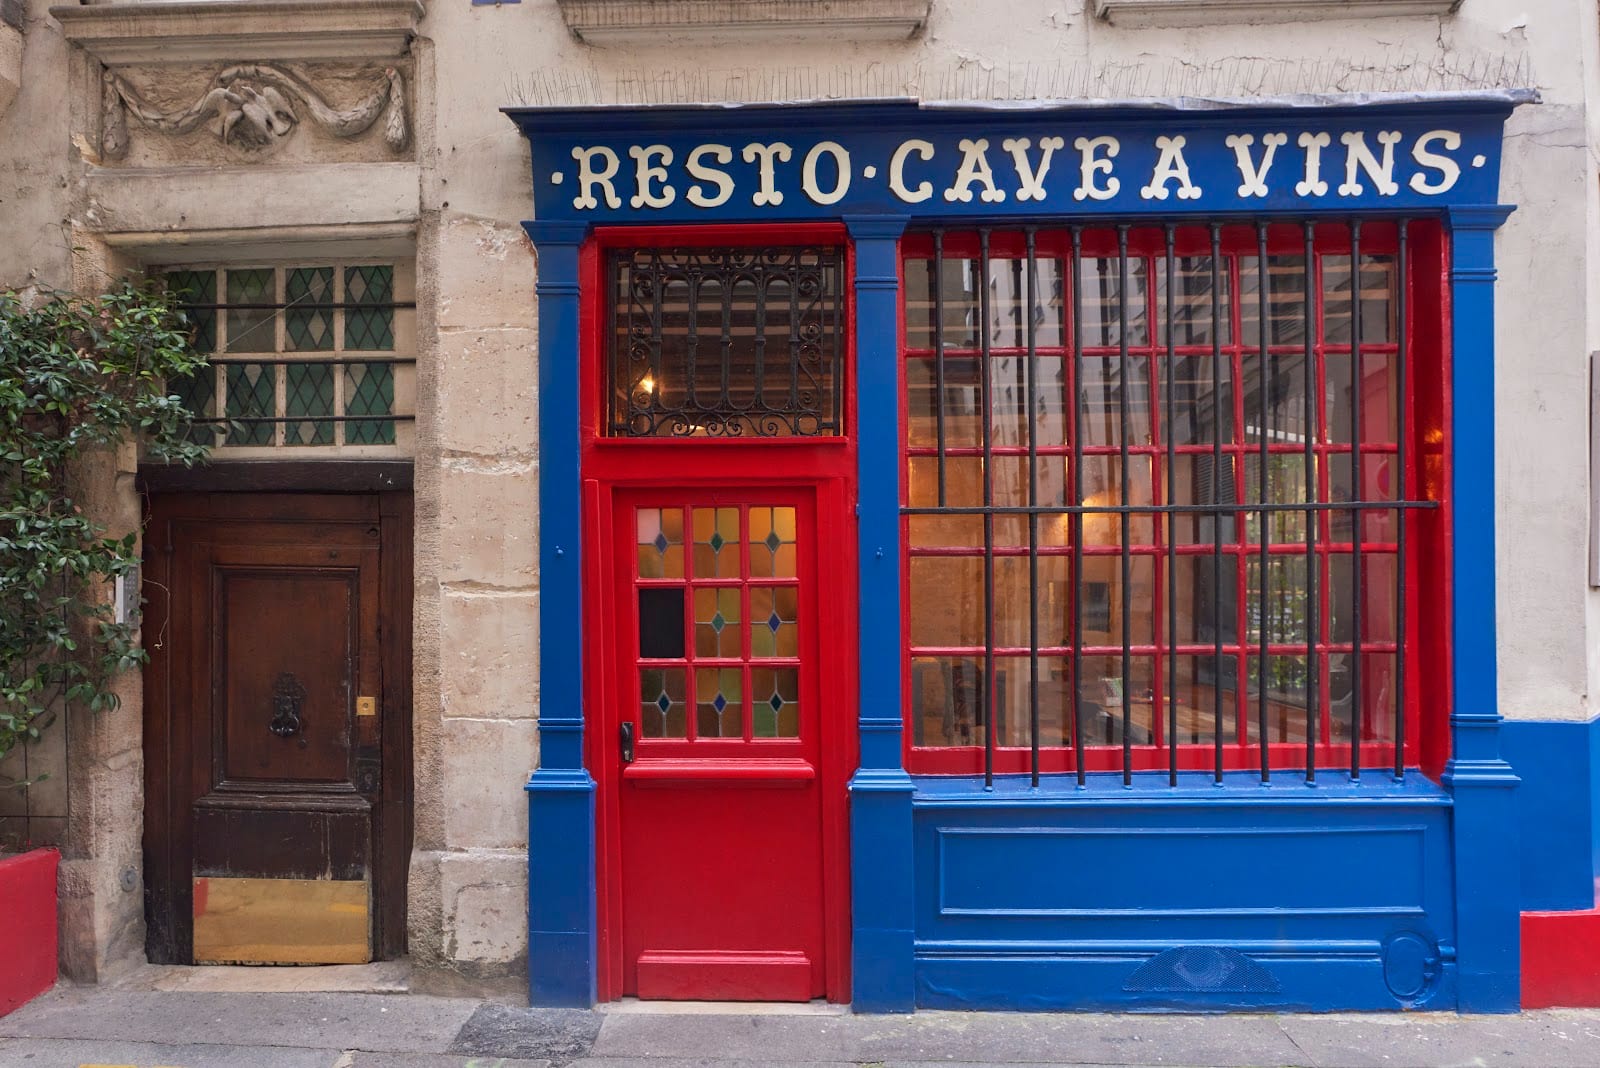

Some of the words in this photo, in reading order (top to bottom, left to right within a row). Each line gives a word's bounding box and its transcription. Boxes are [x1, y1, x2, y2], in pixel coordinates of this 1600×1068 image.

[572, 142, 851, 209] RESTO
[889, 137, 1120, 204] CAVE
[1140, 135, 1203, 200] A
[1226, 130, 1462, 197] VINS
